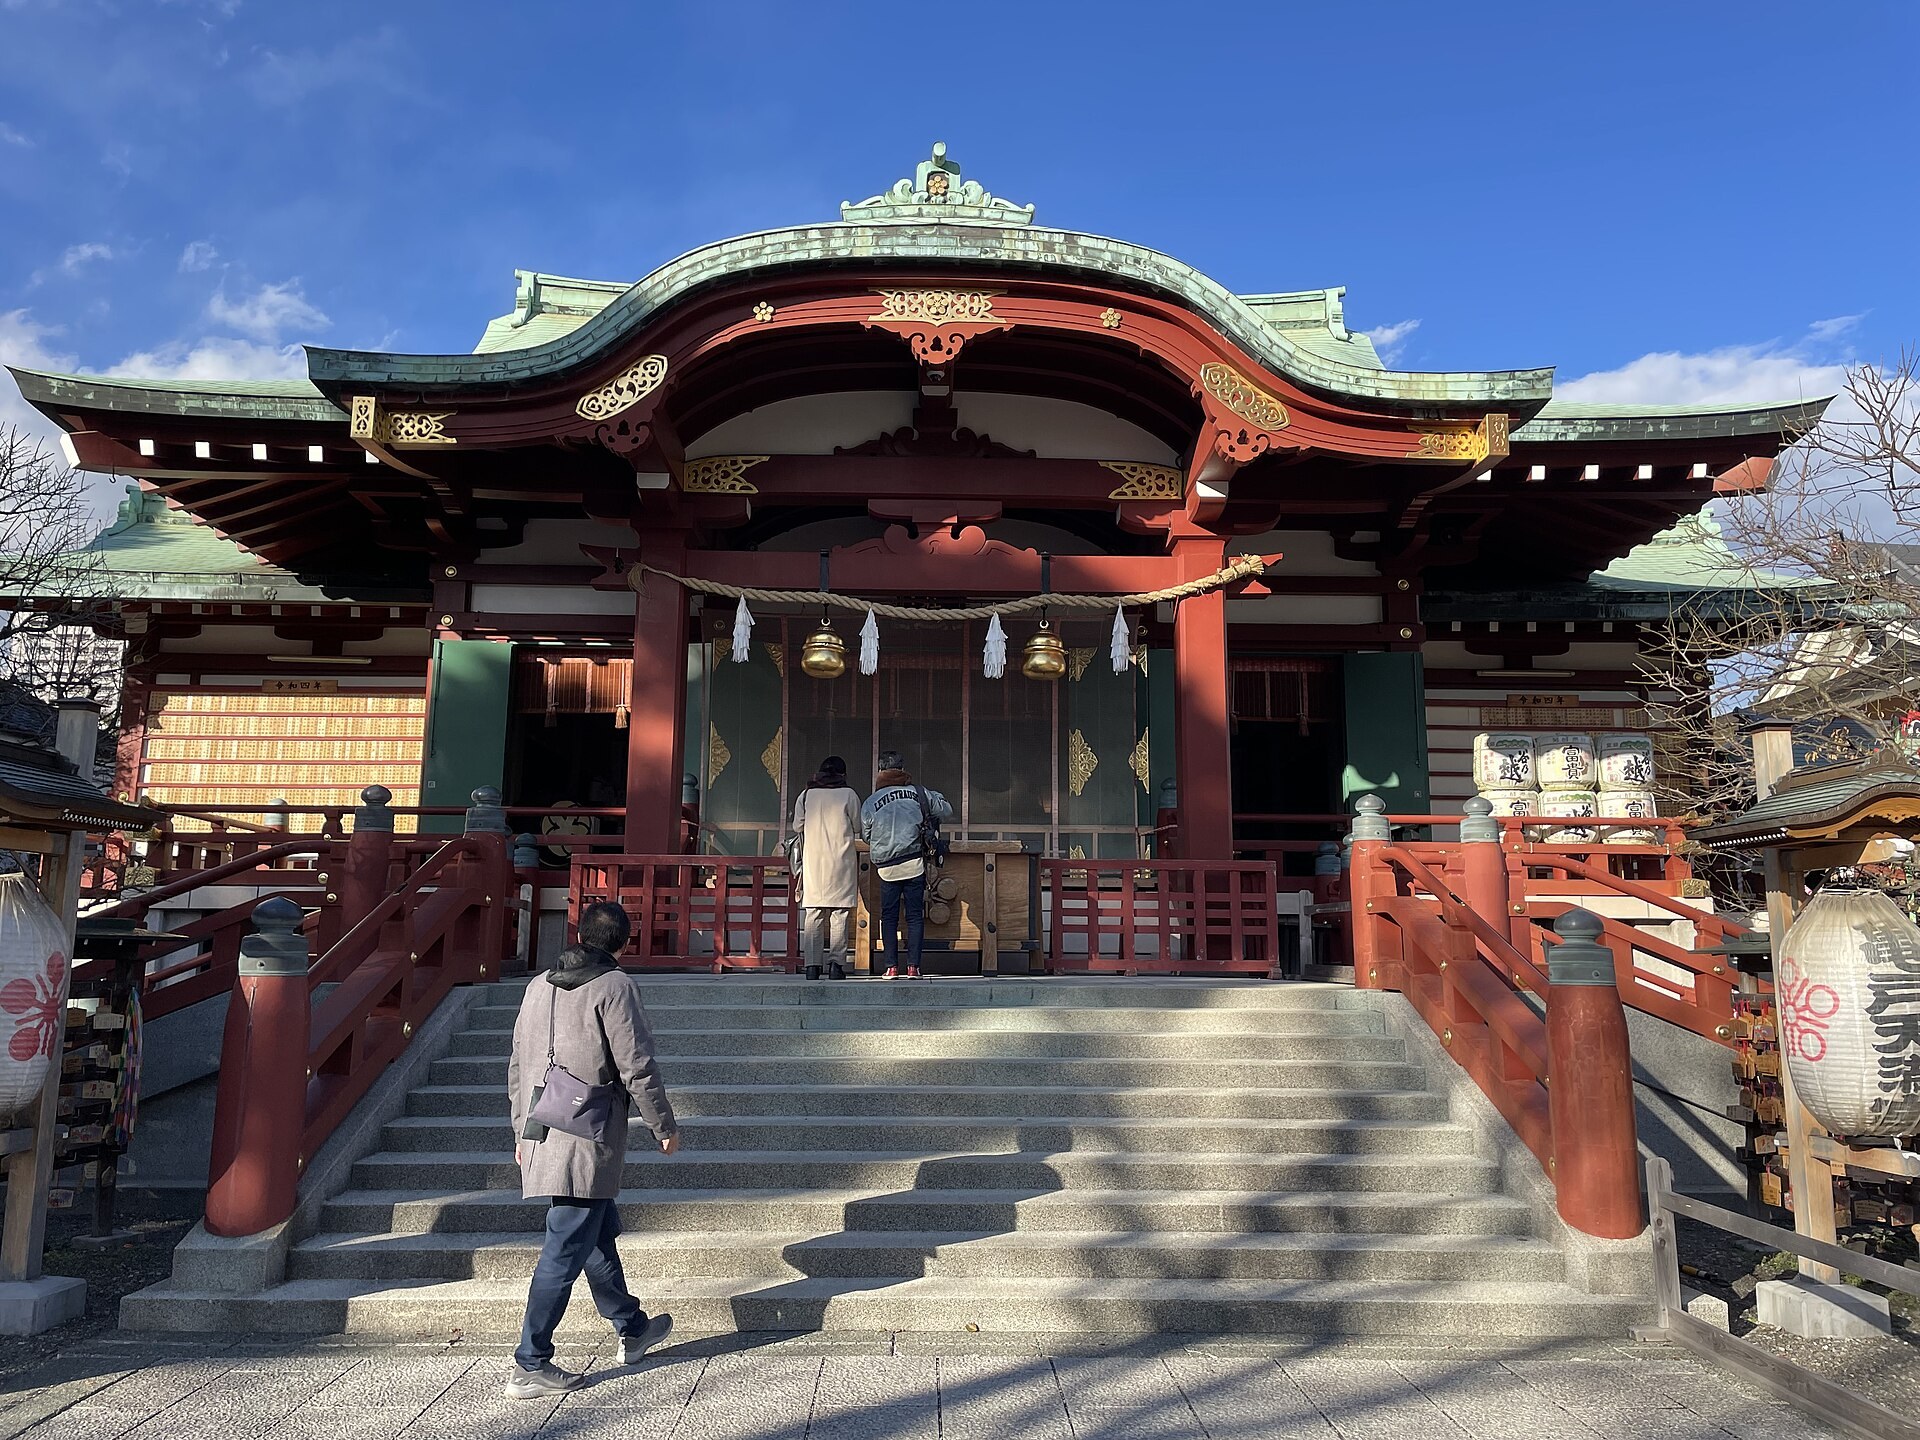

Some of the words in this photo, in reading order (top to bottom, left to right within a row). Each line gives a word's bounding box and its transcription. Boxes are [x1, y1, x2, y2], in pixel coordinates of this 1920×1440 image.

[275, 681, 322, 690] 令和四年
[1519, 695, 1565, 704] 令和四年
[1562, 745, 1583, 779] 富貴
[874, 794, 890, 811] LEVI
